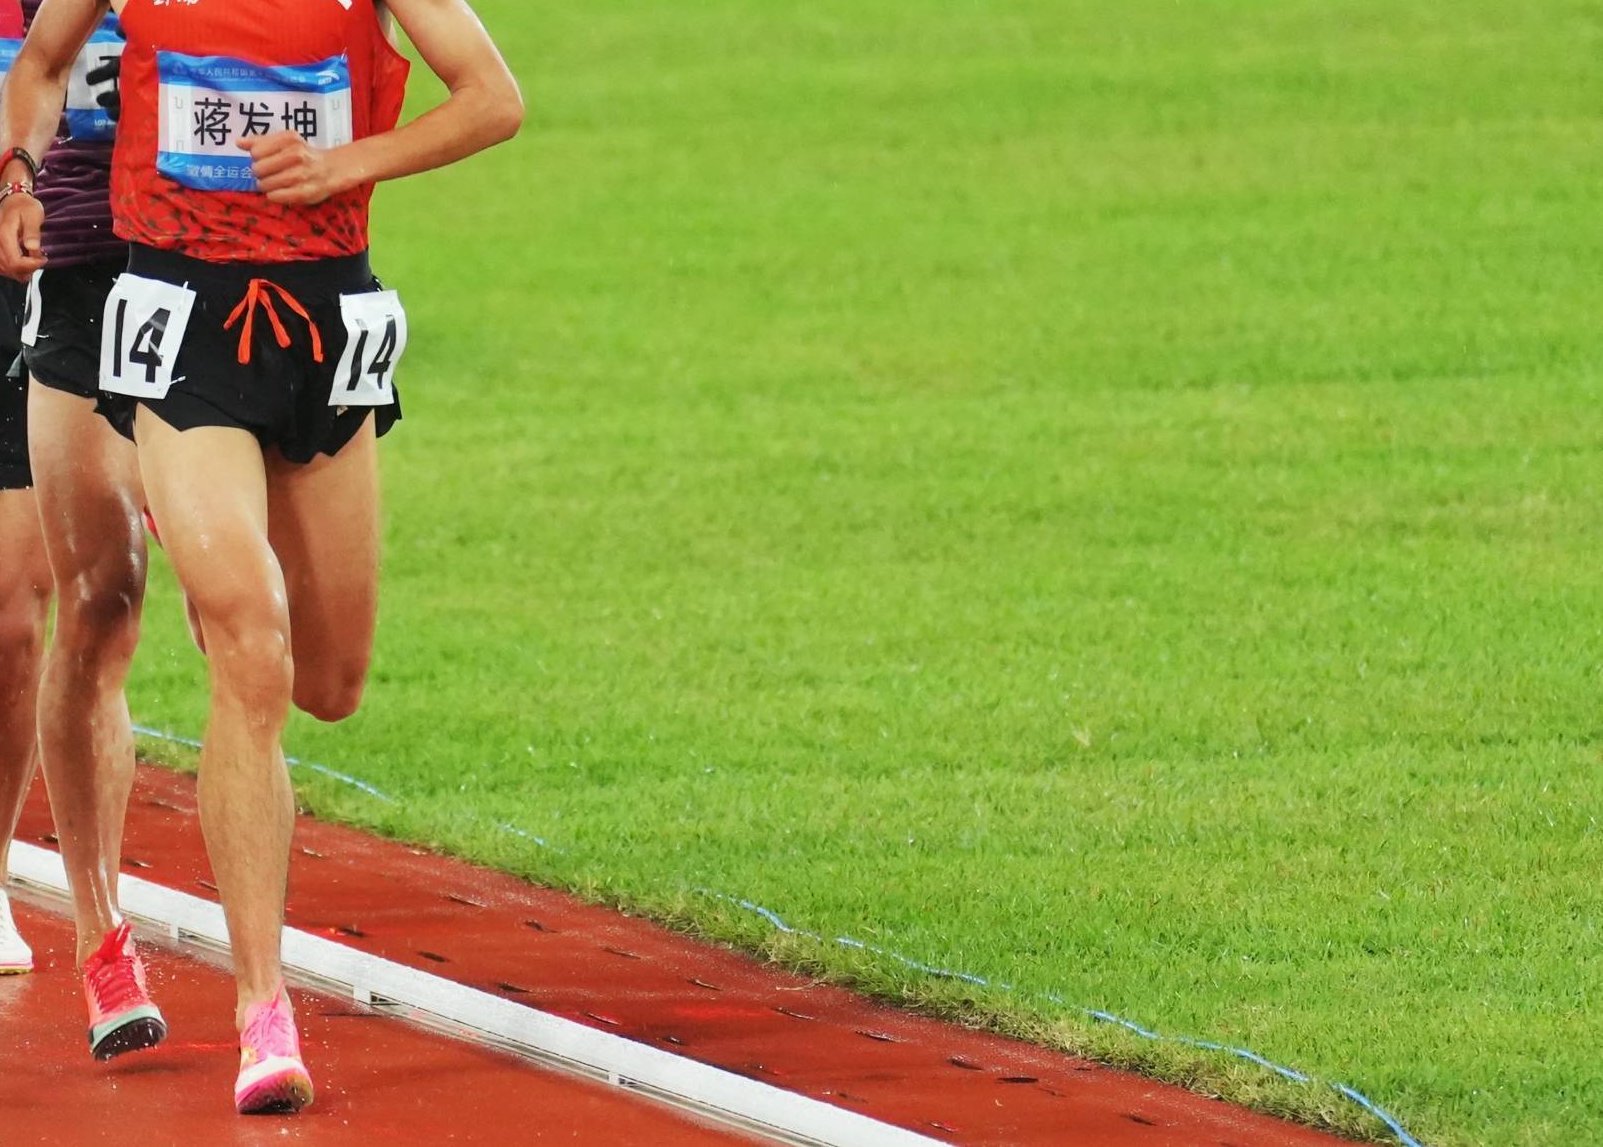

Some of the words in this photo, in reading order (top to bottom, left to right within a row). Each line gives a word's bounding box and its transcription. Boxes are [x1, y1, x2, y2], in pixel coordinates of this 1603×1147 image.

[194, 97, 318, 146] 蒋发坤
[113, 298, 171, 383] 14
[346, 314, 397, 391] 14
